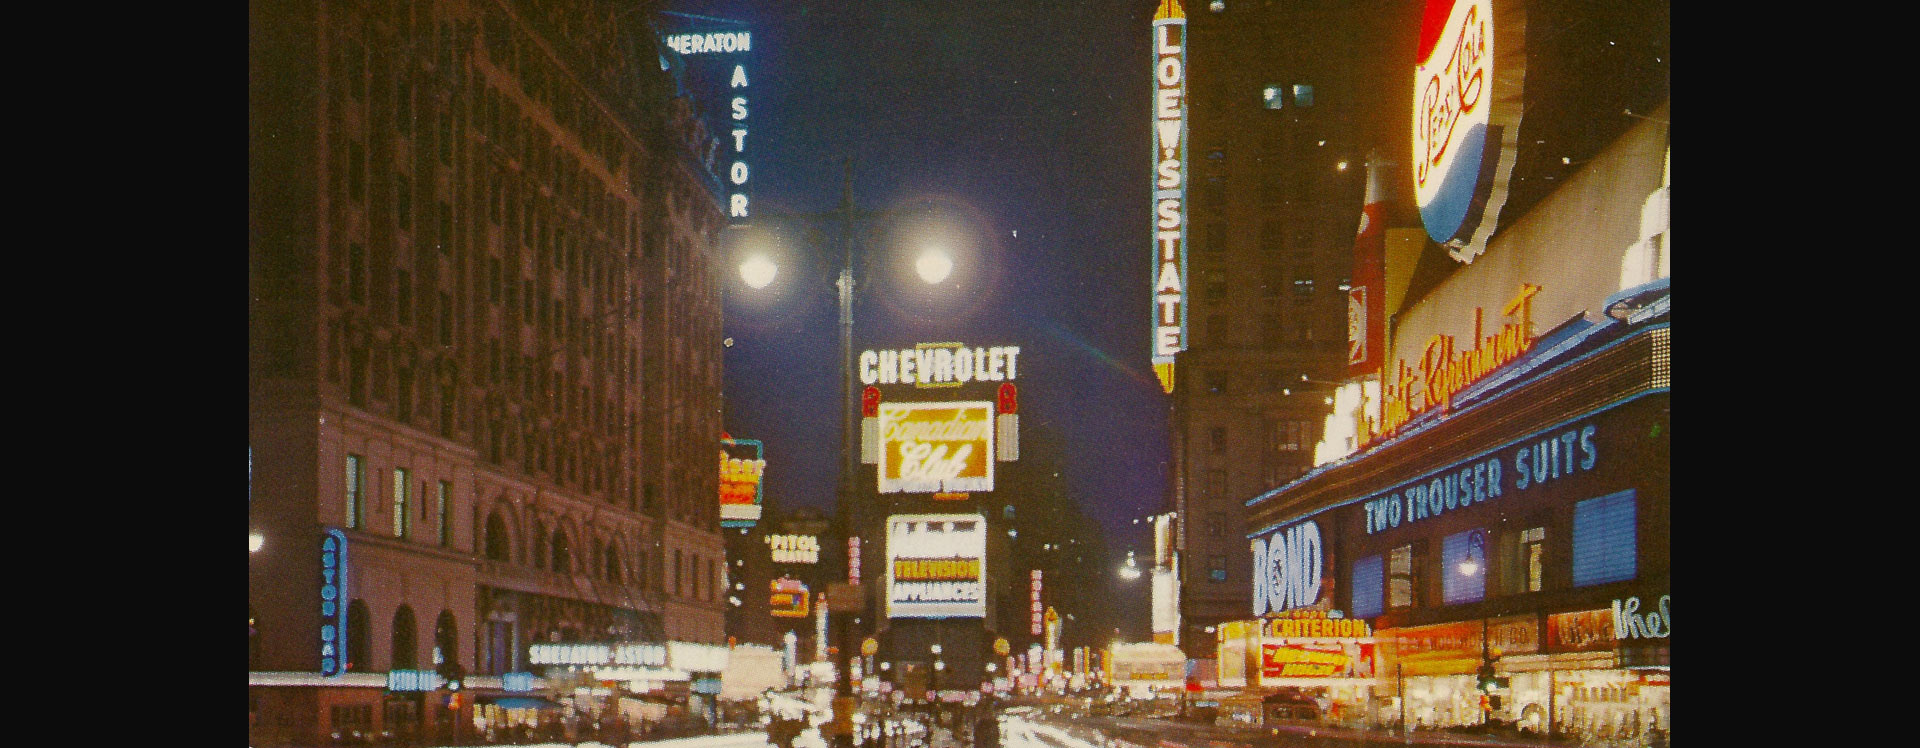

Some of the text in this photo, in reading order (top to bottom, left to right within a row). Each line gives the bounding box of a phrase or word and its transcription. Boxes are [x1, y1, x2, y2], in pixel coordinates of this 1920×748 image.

[730, 65, 748, 217] ASTOR
[1156, 199, 1182, 356] STATE
[859, 345, 1021, 385] CHEVROLET
[1364, 424, 1597, 535] TWO TROUSER SUITS
[893, 559, 981, 578] TELEVISION
[1253, 520, 1323, 617] BOND
[1272, 618, 1366, 638] CRITERION
